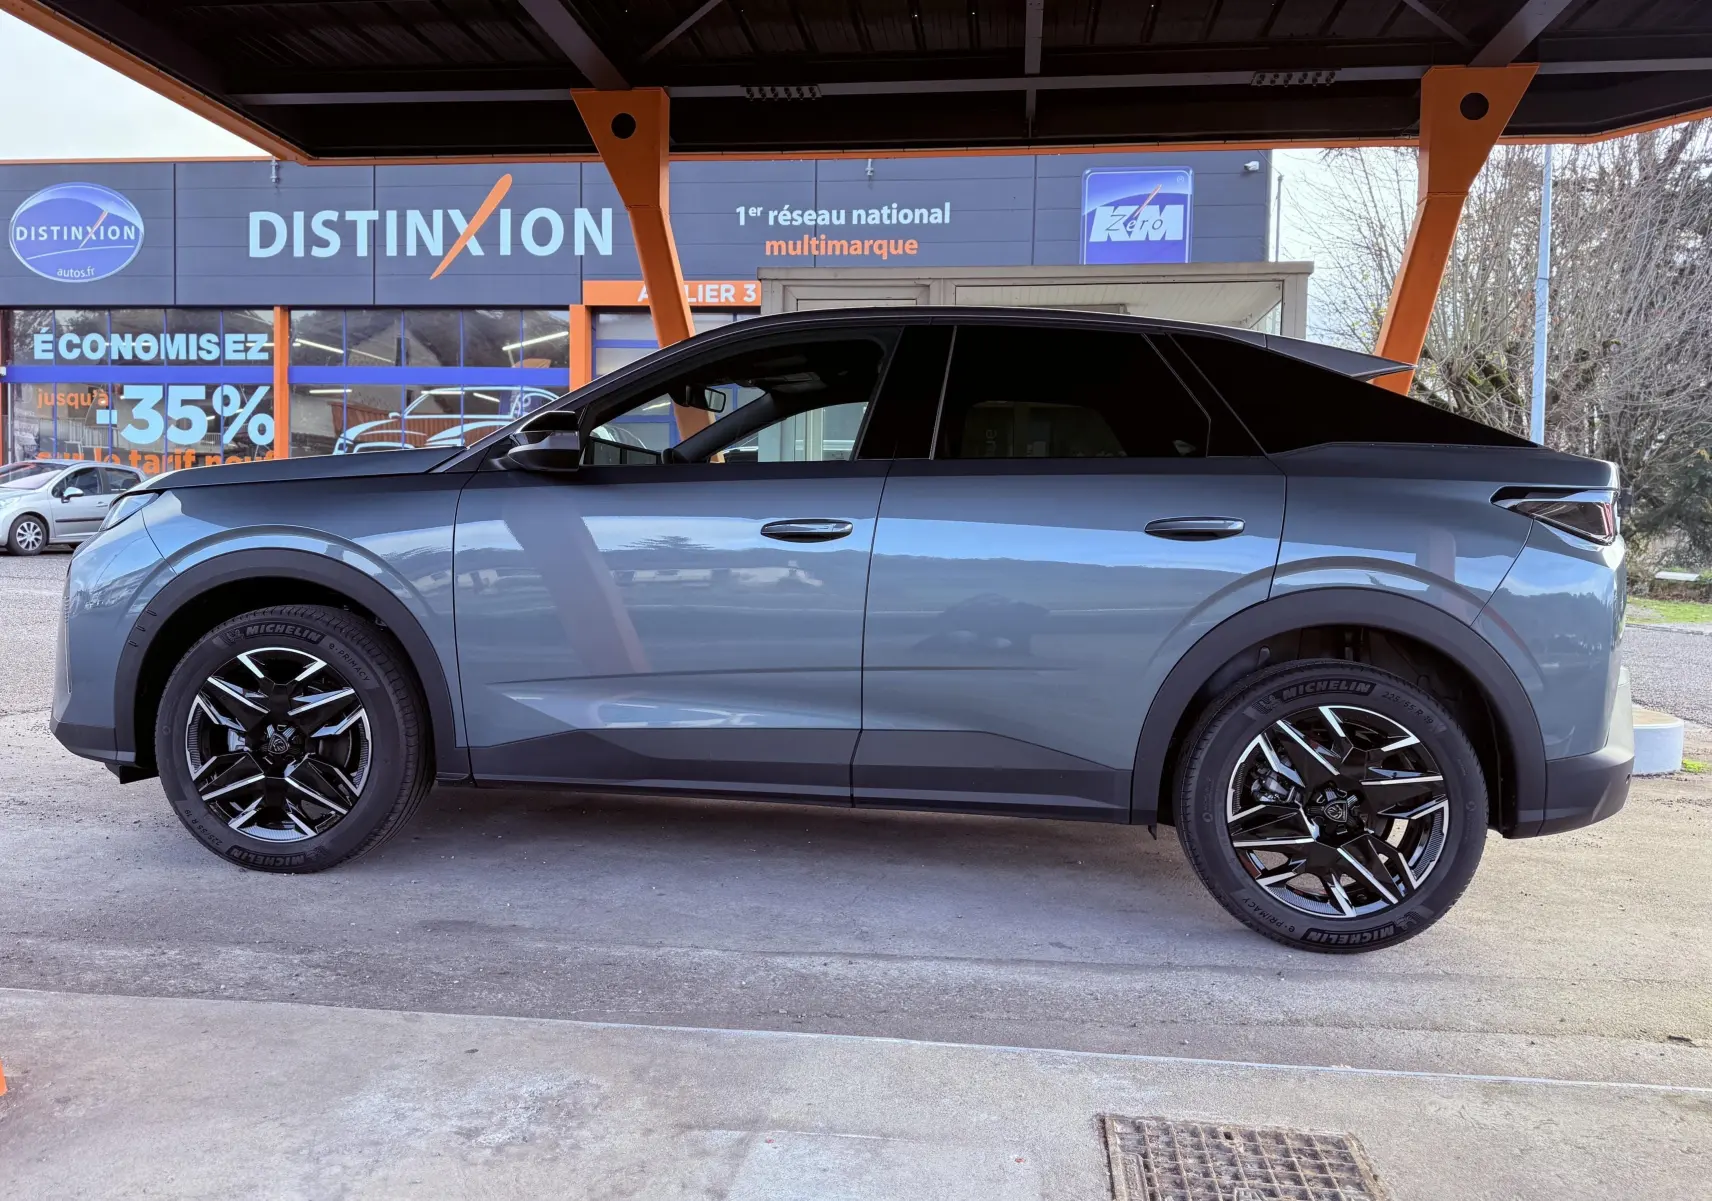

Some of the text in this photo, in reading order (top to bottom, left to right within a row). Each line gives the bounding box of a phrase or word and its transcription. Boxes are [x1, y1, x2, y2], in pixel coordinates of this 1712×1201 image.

[768, 205, 845, 226] réseau
[852, 202, 951, 225] national
[765, 234, 919, 260] multimarque
[57, 266, 96, 279] autos.fr
[743, 283, 757, 303] 3
[33, 327, 269, 361] ÉCONOMISEZ
[96, 384, 275, 446] -35%
[246, 624, 321, 642] MICHELIN
[1282, 680, 1371, 700] MICHELIN
[230, 848, 305, 867] MICHELIN
[1307, 925, 1395, 946] MICHELIN
